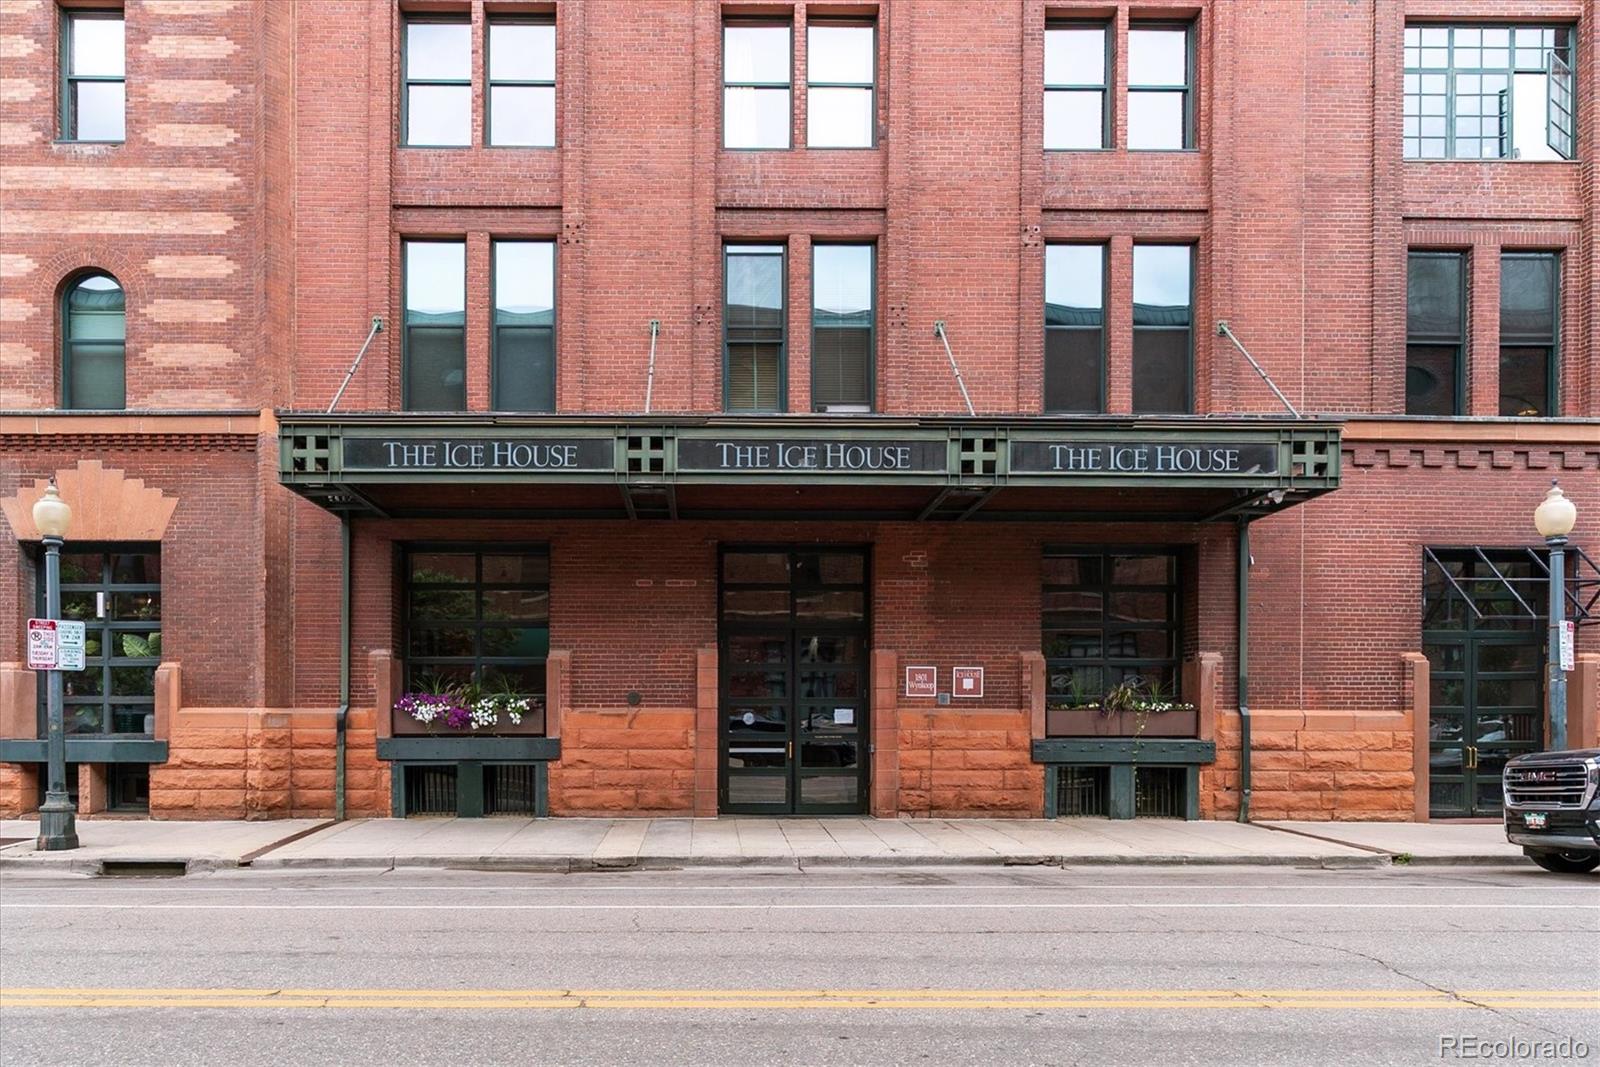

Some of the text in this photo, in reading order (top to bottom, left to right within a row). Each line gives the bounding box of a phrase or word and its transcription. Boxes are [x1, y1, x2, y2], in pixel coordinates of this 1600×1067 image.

[382, 441, 578, 468] THE ICE HOUSE
[715, 442, 911, 469] THE ICE HOUSE
[1049, 444, 1240, 471] THE ICE HOUSE
[908, 680, 935, 691] Wynkoop
[1520, 771, 1556, 781] GMC
